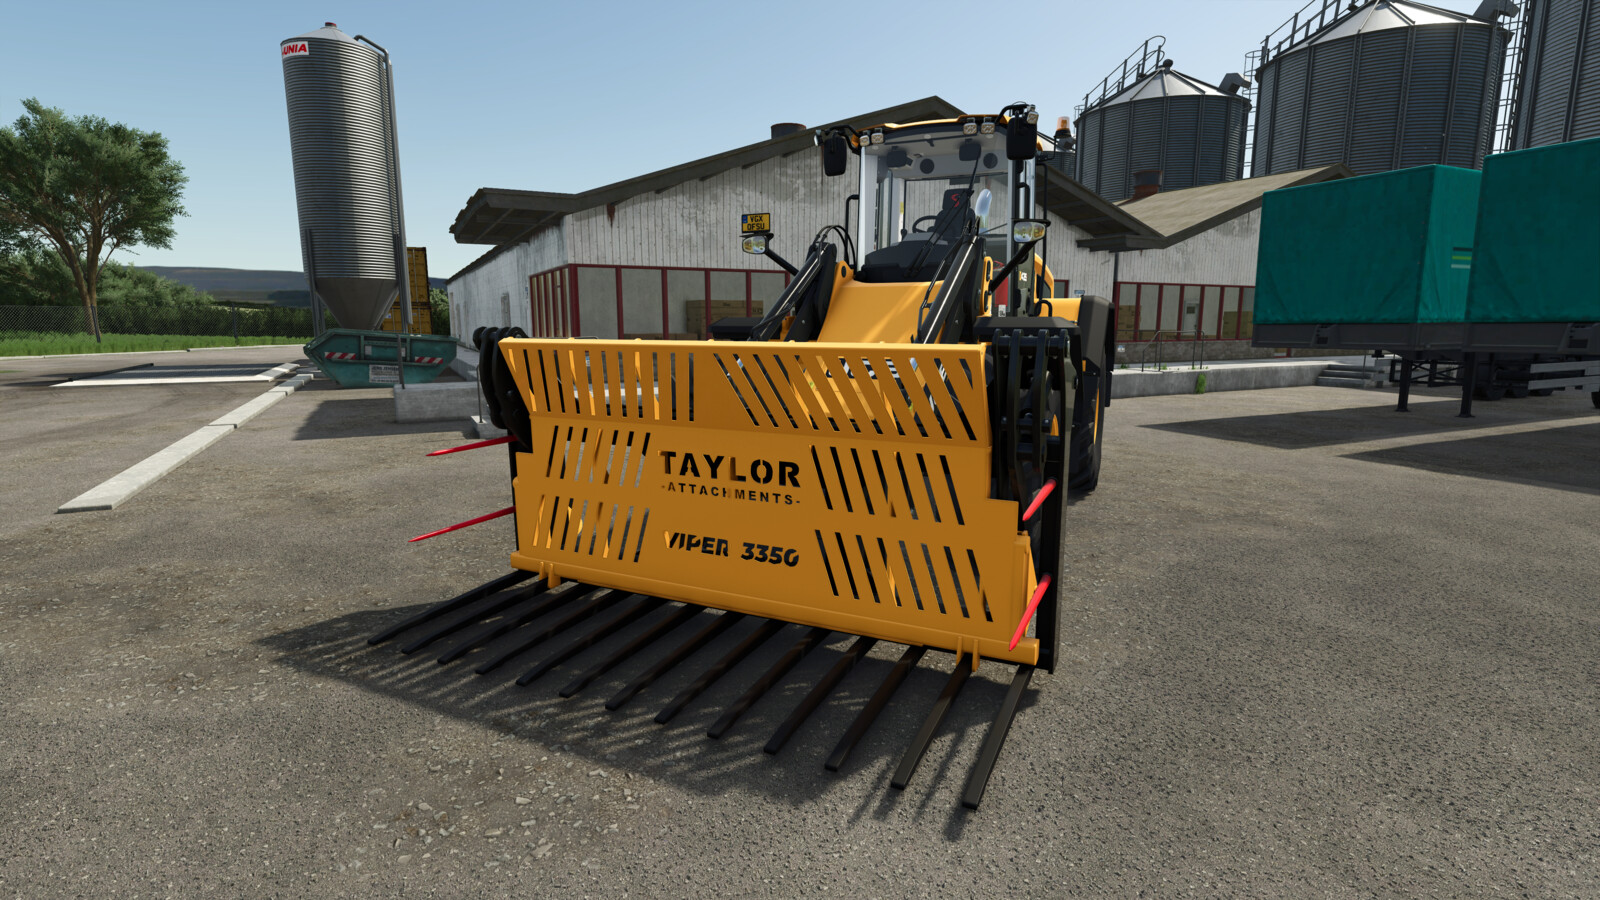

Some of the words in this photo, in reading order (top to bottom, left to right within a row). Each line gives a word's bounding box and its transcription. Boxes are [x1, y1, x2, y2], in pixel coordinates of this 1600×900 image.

[282, 43, 308, 55] UNIA
[658, 450, 800, 488] TAYLOR
[664, 530, 729, 557] VIPER
[741, 542, 799, 567] 3350
